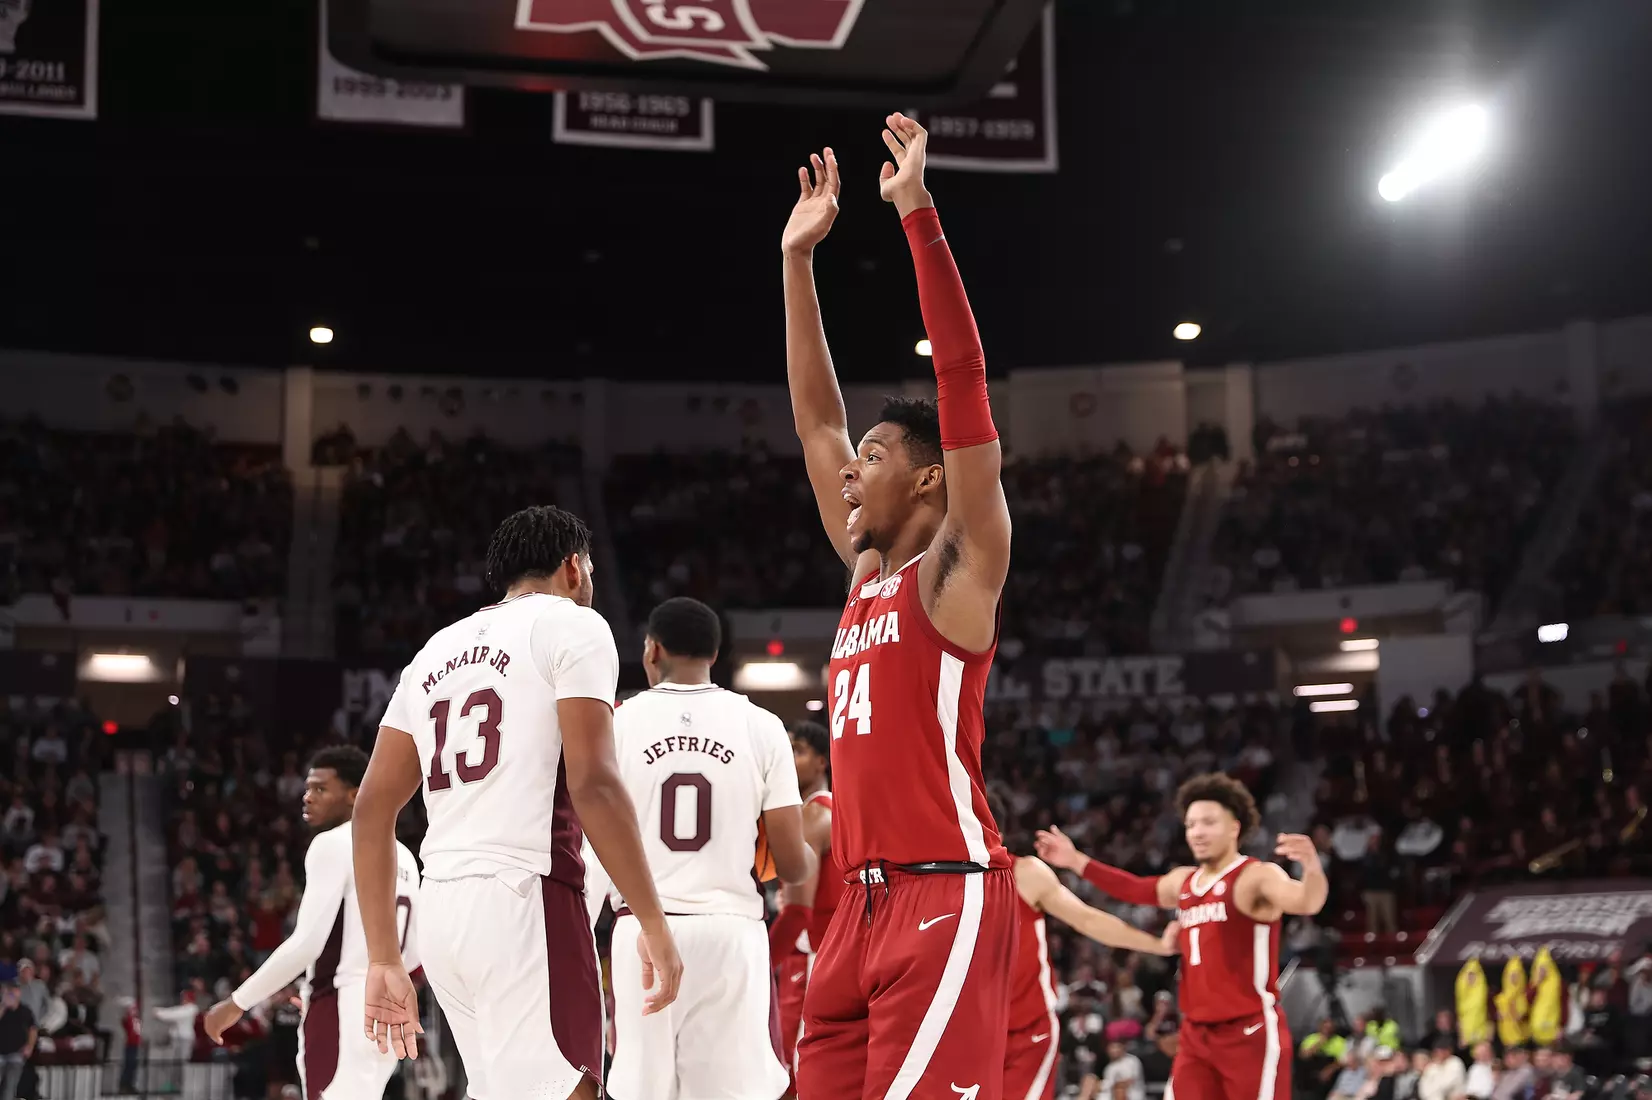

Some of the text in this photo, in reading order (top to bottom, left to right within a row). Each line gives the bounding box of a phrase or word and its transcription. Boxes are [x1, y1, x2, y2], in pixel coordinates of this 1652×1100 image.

[422, 646, 490, 695] McNAIR
[490, 649, 511, 677] JR.
[1043, 655, 1187, 698] STATE
[831, 663, 873, 740] 24
[427, 686, 504, 793] 13
[643, 735, 734, 765] JEFFRIES
[660, 772, 712, 852] 0
[1189, 927, 1201, 966] 1
